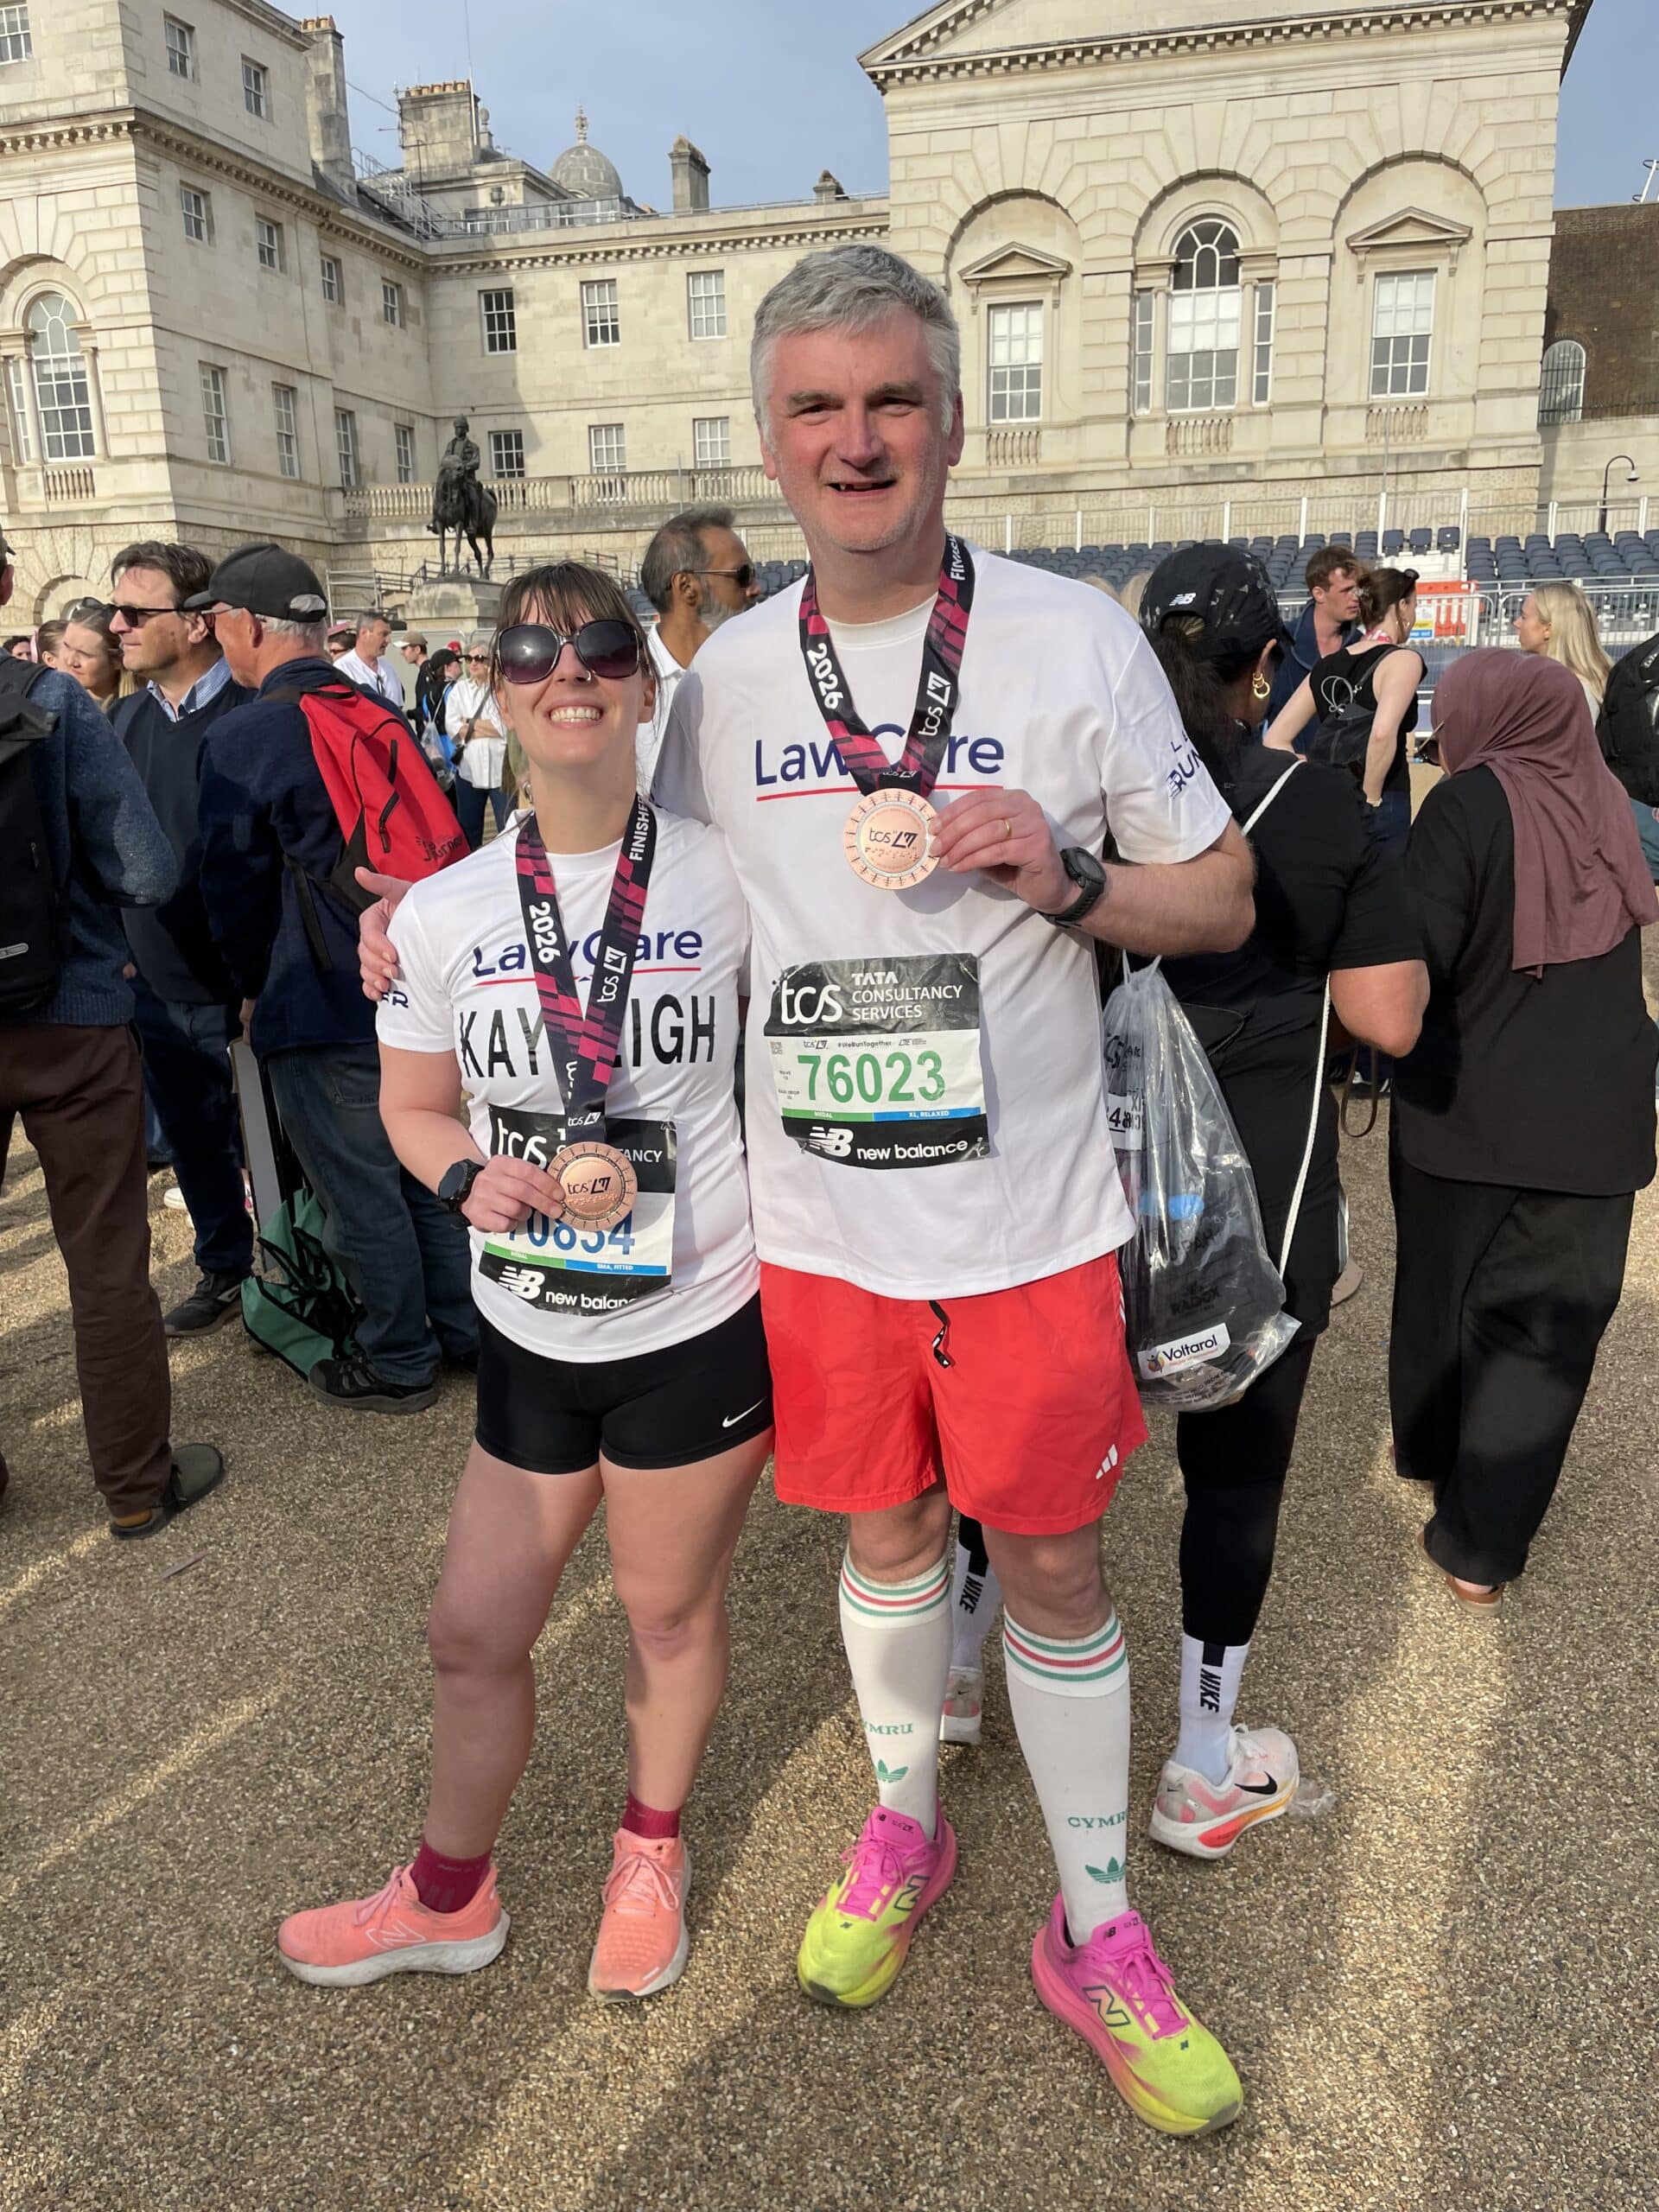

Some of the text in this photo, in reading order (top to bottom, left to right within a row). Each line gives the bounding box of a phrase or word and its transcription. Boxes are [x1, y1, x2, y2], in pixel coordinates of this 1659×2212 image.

[807, 643, 844, 709] 2026
[918, 706, 944, 736] tcs
[869, 827, 891, 843] tcs
[529, 901, 561, 963] 2026
[596, 976, 620, 1002] tcs
[851, 971, 899, 985] TATA
[781, 980, 843, 1025] tcs
[852, 985, 963, 1003] CONSULTANCY
[853, 1005, 922, 1021] SERVICES
[460, 994, 715, 1077] KAYIGH
[798, 1051, 945, 1103] 76023
[568, 1116, 583, 1127] tcs
[856, 1137, 969, 1160] new balance
[568, 1182, 588, 1194] tcs
[545, 1291, 577, 1306] new
[1162, 1334, 1217, 1362] Voltarol
[959, 1573, 985, 1614] NIKE
[1200, 1668, 1222, 1713] NIKE
